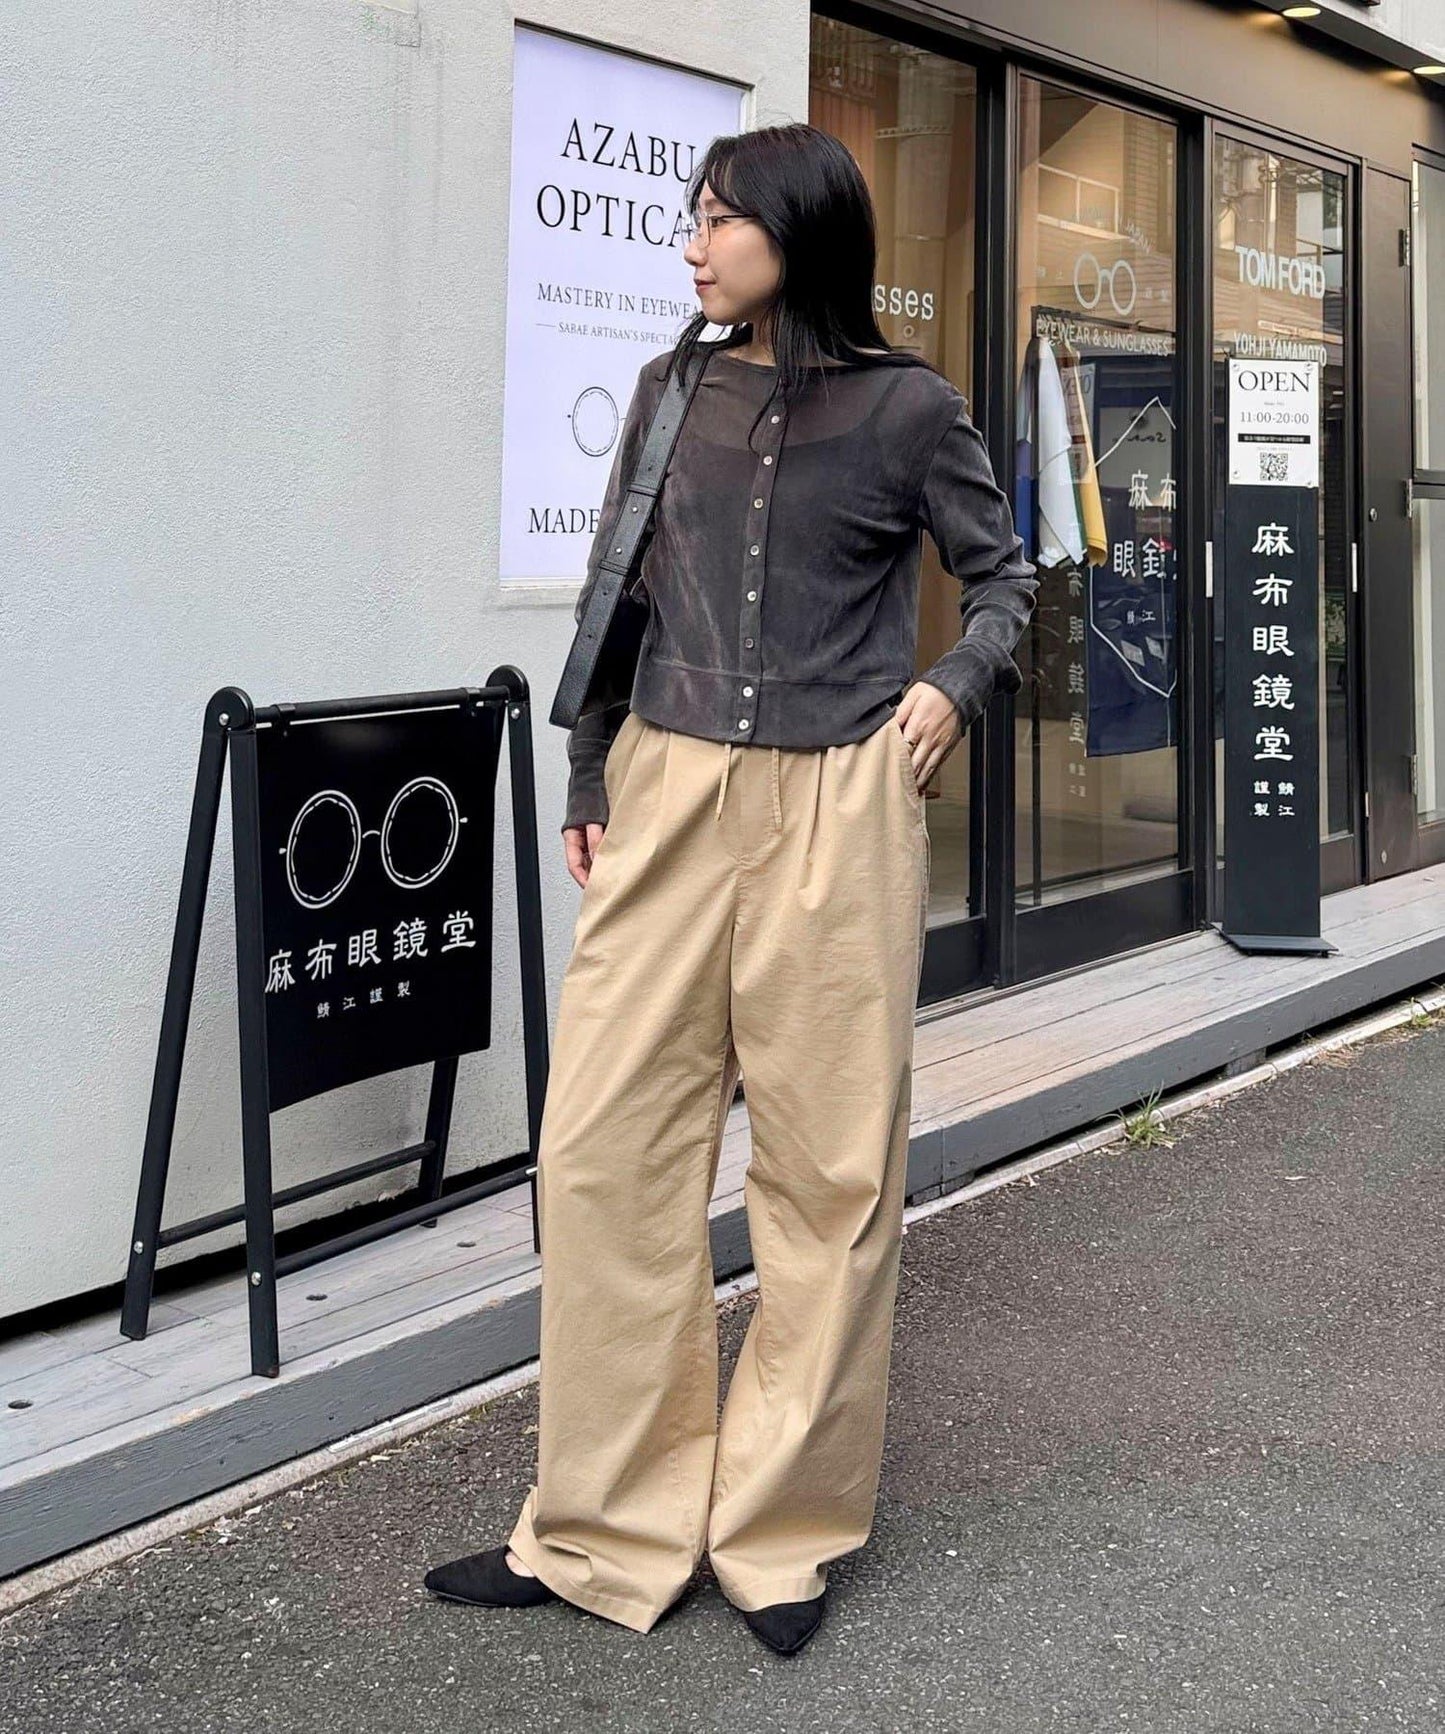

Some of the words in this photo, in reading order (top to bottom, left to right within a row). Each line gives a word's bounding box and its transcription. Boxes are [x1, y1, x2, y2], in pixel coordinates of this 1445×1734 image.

[561, 118, 697, 183] AZABU
[1235, 245, 1276, 290] TOM
[1278, 255, 1326, 299] FORD
[537, 283, 613, 310] MASTERY
[619, 294, 636, 312] IN
[558, 321, 588, 337] SABAE
[1036, 317, 1091, 344] EYEWEAR
[1092, 328, 1101, 346] &
[1102, 330, 1170, 357] SUNGLASSES
[1233, 331, 1268, 357] YOHJI
[1268, 336, 1327, 367] YAMAMOTO
[1238, 370, 1310, 392] OPEN
[1240, 411, 1310, 424] 11:00-20:00
[528, 508, 600, 534] MADE
[1251, 522, 1296, 762] 麻布眼鏡堂
[264, 910, 477, 994] 麻布眼鏡堂
